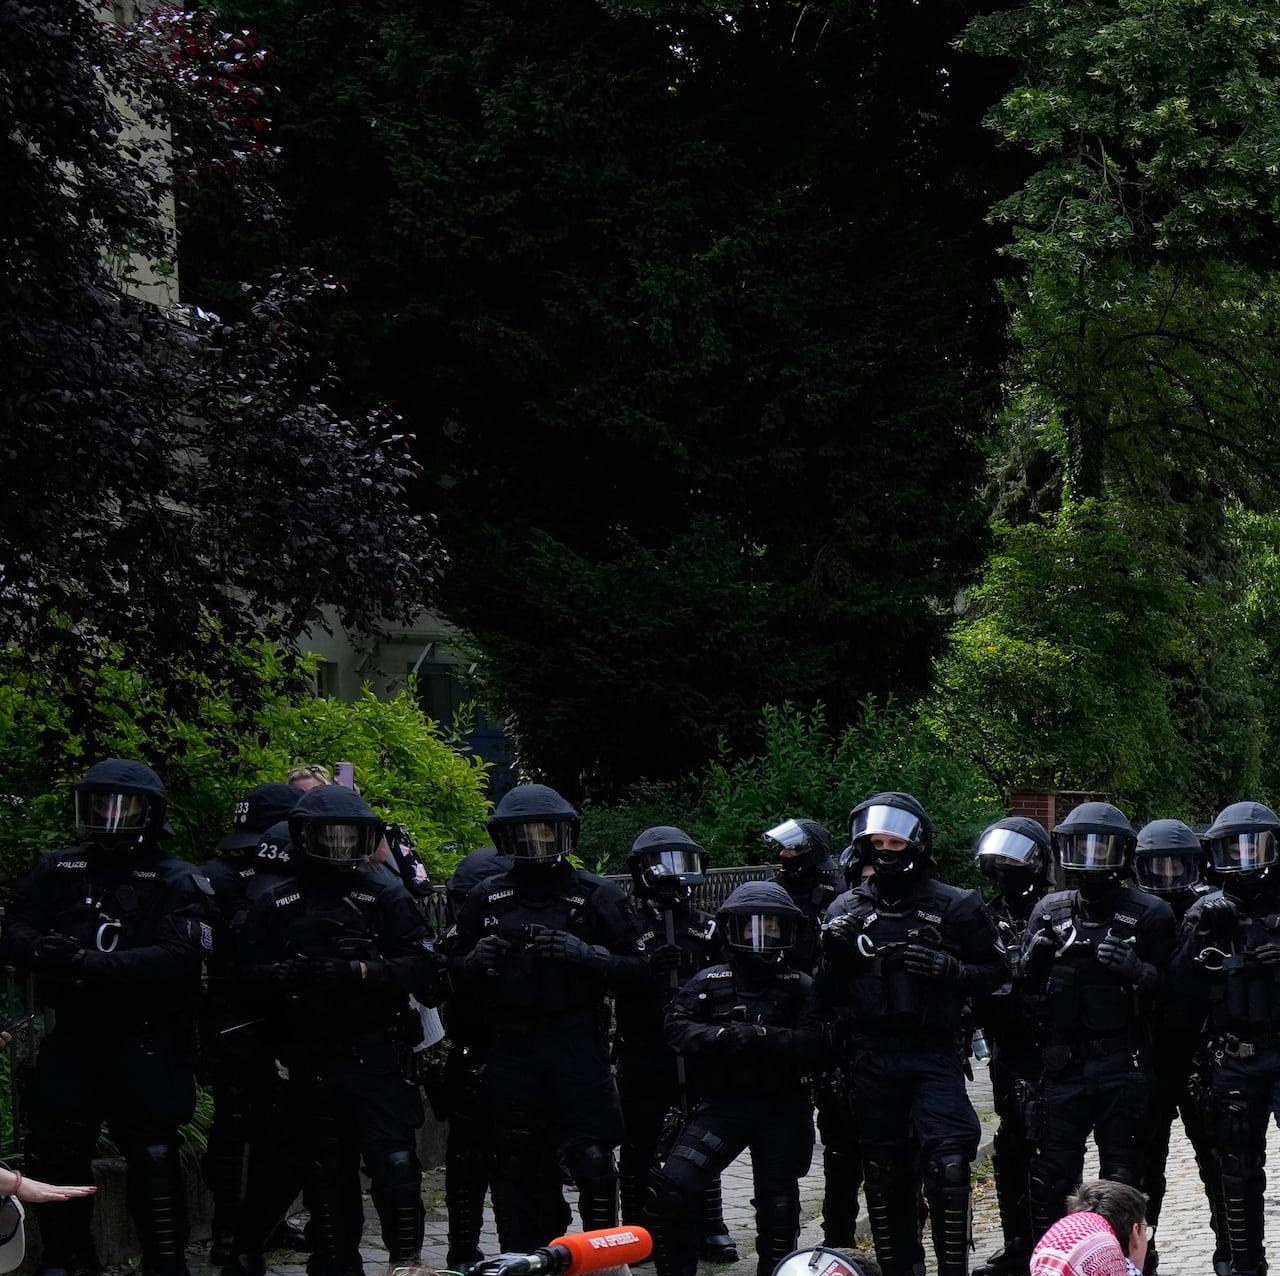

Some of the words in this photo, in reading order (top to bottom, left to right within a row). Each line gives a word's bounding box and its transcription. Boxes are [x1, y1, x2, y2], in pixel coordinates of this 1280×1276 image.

[257, 842, 291, 864] 234
[57, 861, 88, 869] POLIZEI
[488, 888, 515, 903] POLIZEI
[706, 970, 733, 979] POLIZEI
